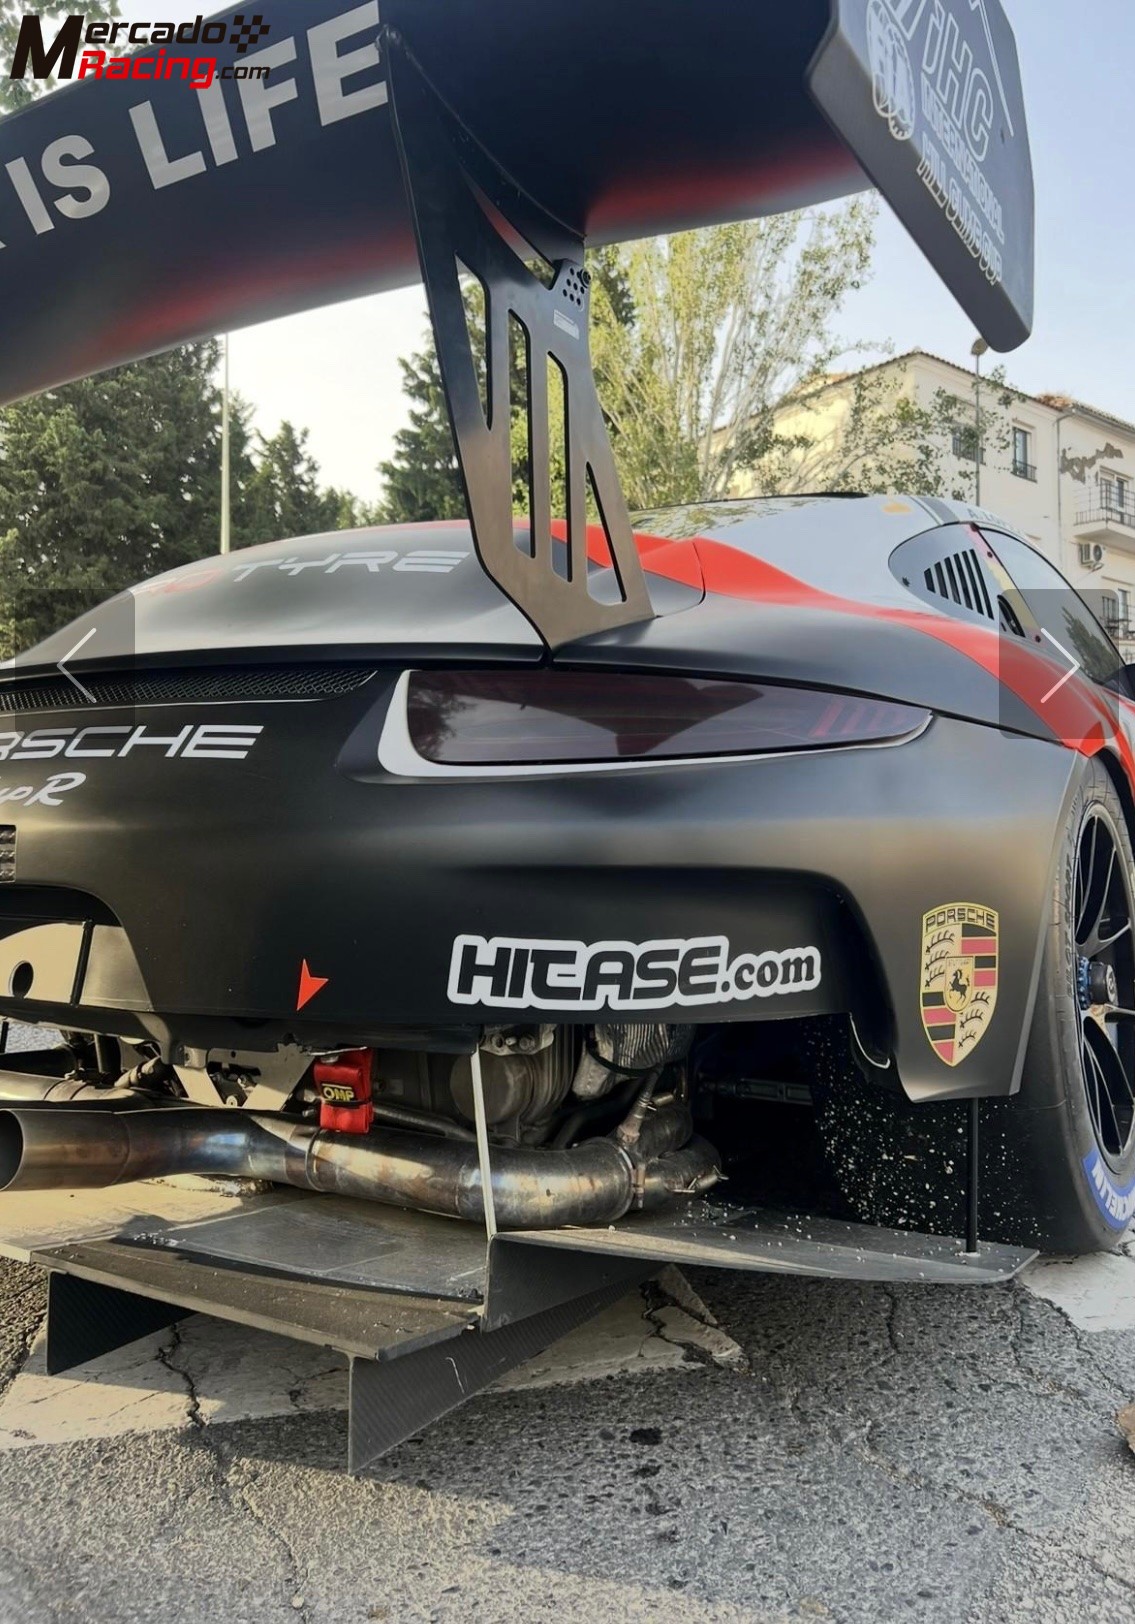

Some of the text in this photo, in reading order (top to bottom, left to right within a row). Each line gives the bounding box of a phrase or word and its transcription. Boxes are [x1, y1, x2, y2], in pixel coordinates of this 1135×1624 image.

[5, 0, 388, 235] IS LIFE
[925, 907, 997, 933] PORSCHE
[323, 1086, 355, 1102] OMP
